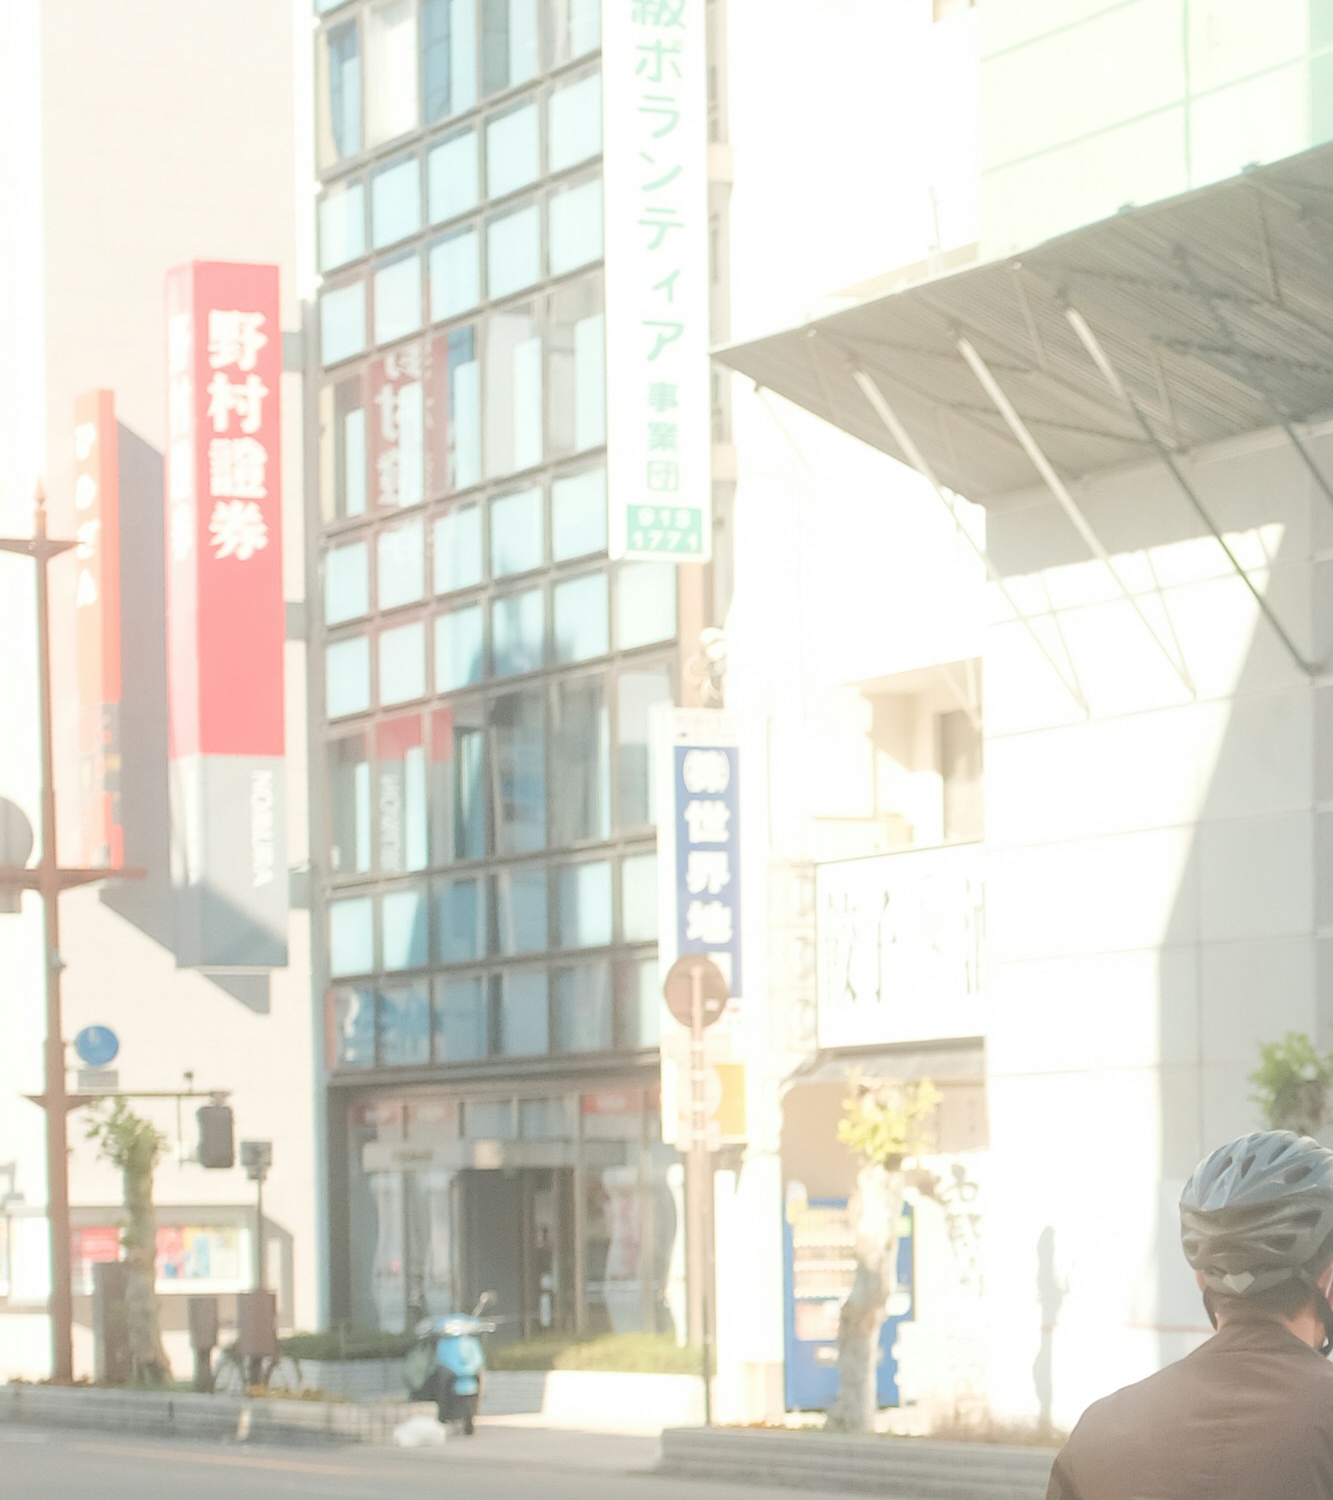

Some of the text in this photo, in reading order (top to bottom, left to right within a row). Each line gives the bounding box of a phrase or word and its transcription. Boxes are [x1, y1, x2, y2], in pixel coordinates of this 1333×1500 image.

[207, 308, 268, 561] 野村證券
[631, 529, 699, 551] 1771
